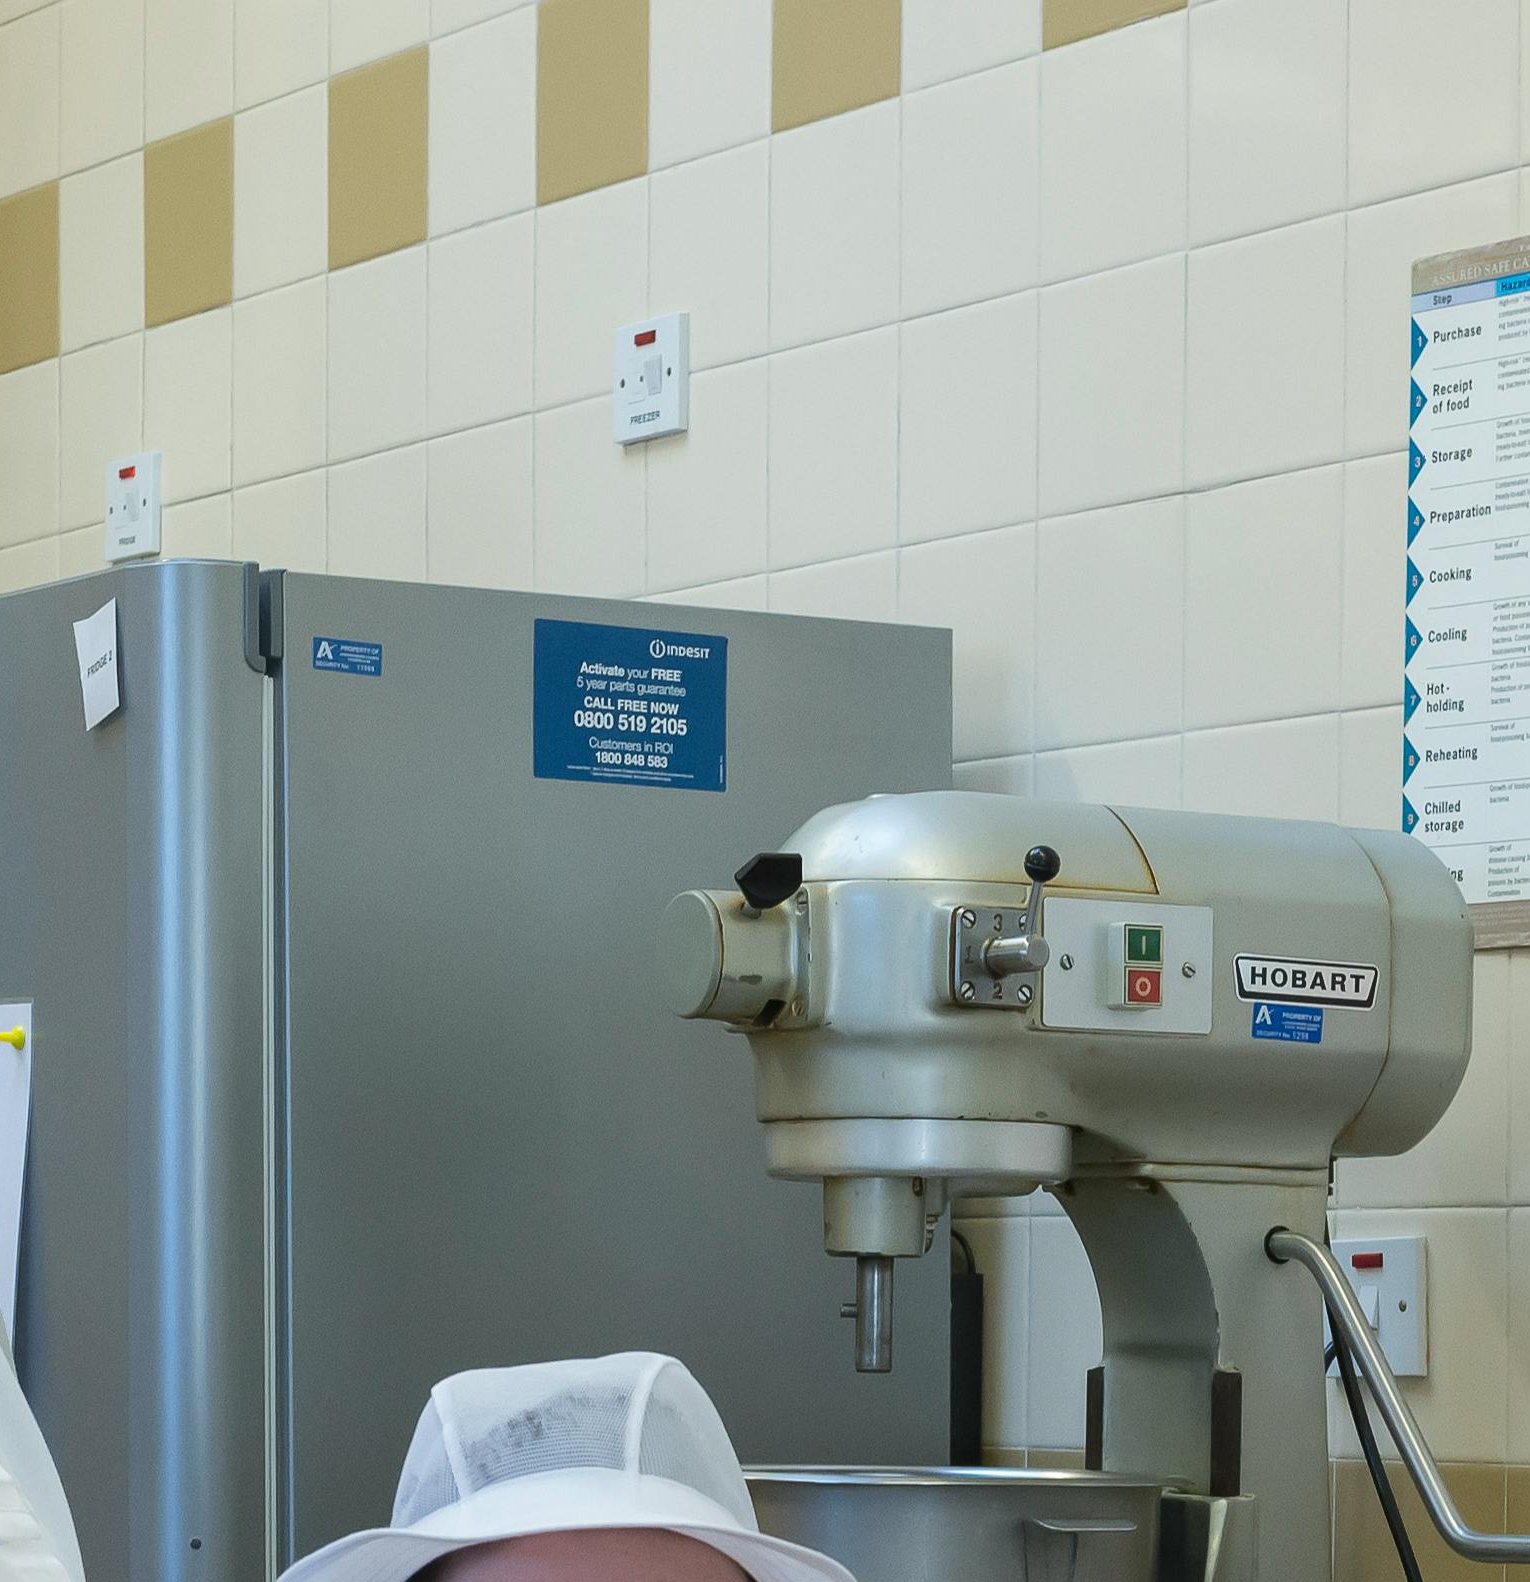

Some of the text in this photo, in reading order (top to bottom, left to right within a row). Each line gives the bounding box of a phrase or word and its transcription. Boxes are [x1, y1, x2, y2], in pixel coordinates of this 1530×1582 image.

[1430, 266, 1483, 286] ASSURED
[1485, 261, 1510, 274] SAFE
[1433, 294, 1452, 305] Step
[1433, 326, 1482, 343] Purchase
[1433, 379, 1472, 396] Receipt
[1433, 397, 1470, 414] of food
[630, 410, 660, 425] FREEZER
[1432, 448, 1472, 463] Storage
[1430, 505, 1491, 524] Preparation
[1430, 567, 1471, 583] Cooking
[1428, 628, 1467, 643] Cooling
[87, 653, 107, 678] FRIDGE
[580, 662, 624, 678] Activate
[627, 669, 649, 680] your
[586, 679, 607, 691] year
[609, 681, 635, 693] parts
[638, 684, 686, 697] guarantee
[584, 696, 679, 715] CALL FREE NOW
[1427, 700, 1464, 713] holding
[574, 710, 687, 736] 0800 519 2105
[589, 736, 673, 754] Customers in ROI
[596, 752, 668, 768] 1800 848 583
[1426, 746, 1477, 762] Reheating
[1425, 800, 1461, 815] Chilled
[1425, 820, 1464, 832] storage
[993, 913, 1003, 932] 3
[1251, 966, 1365, 993] HOBART
[992, 982, 1003, 1000] 2
